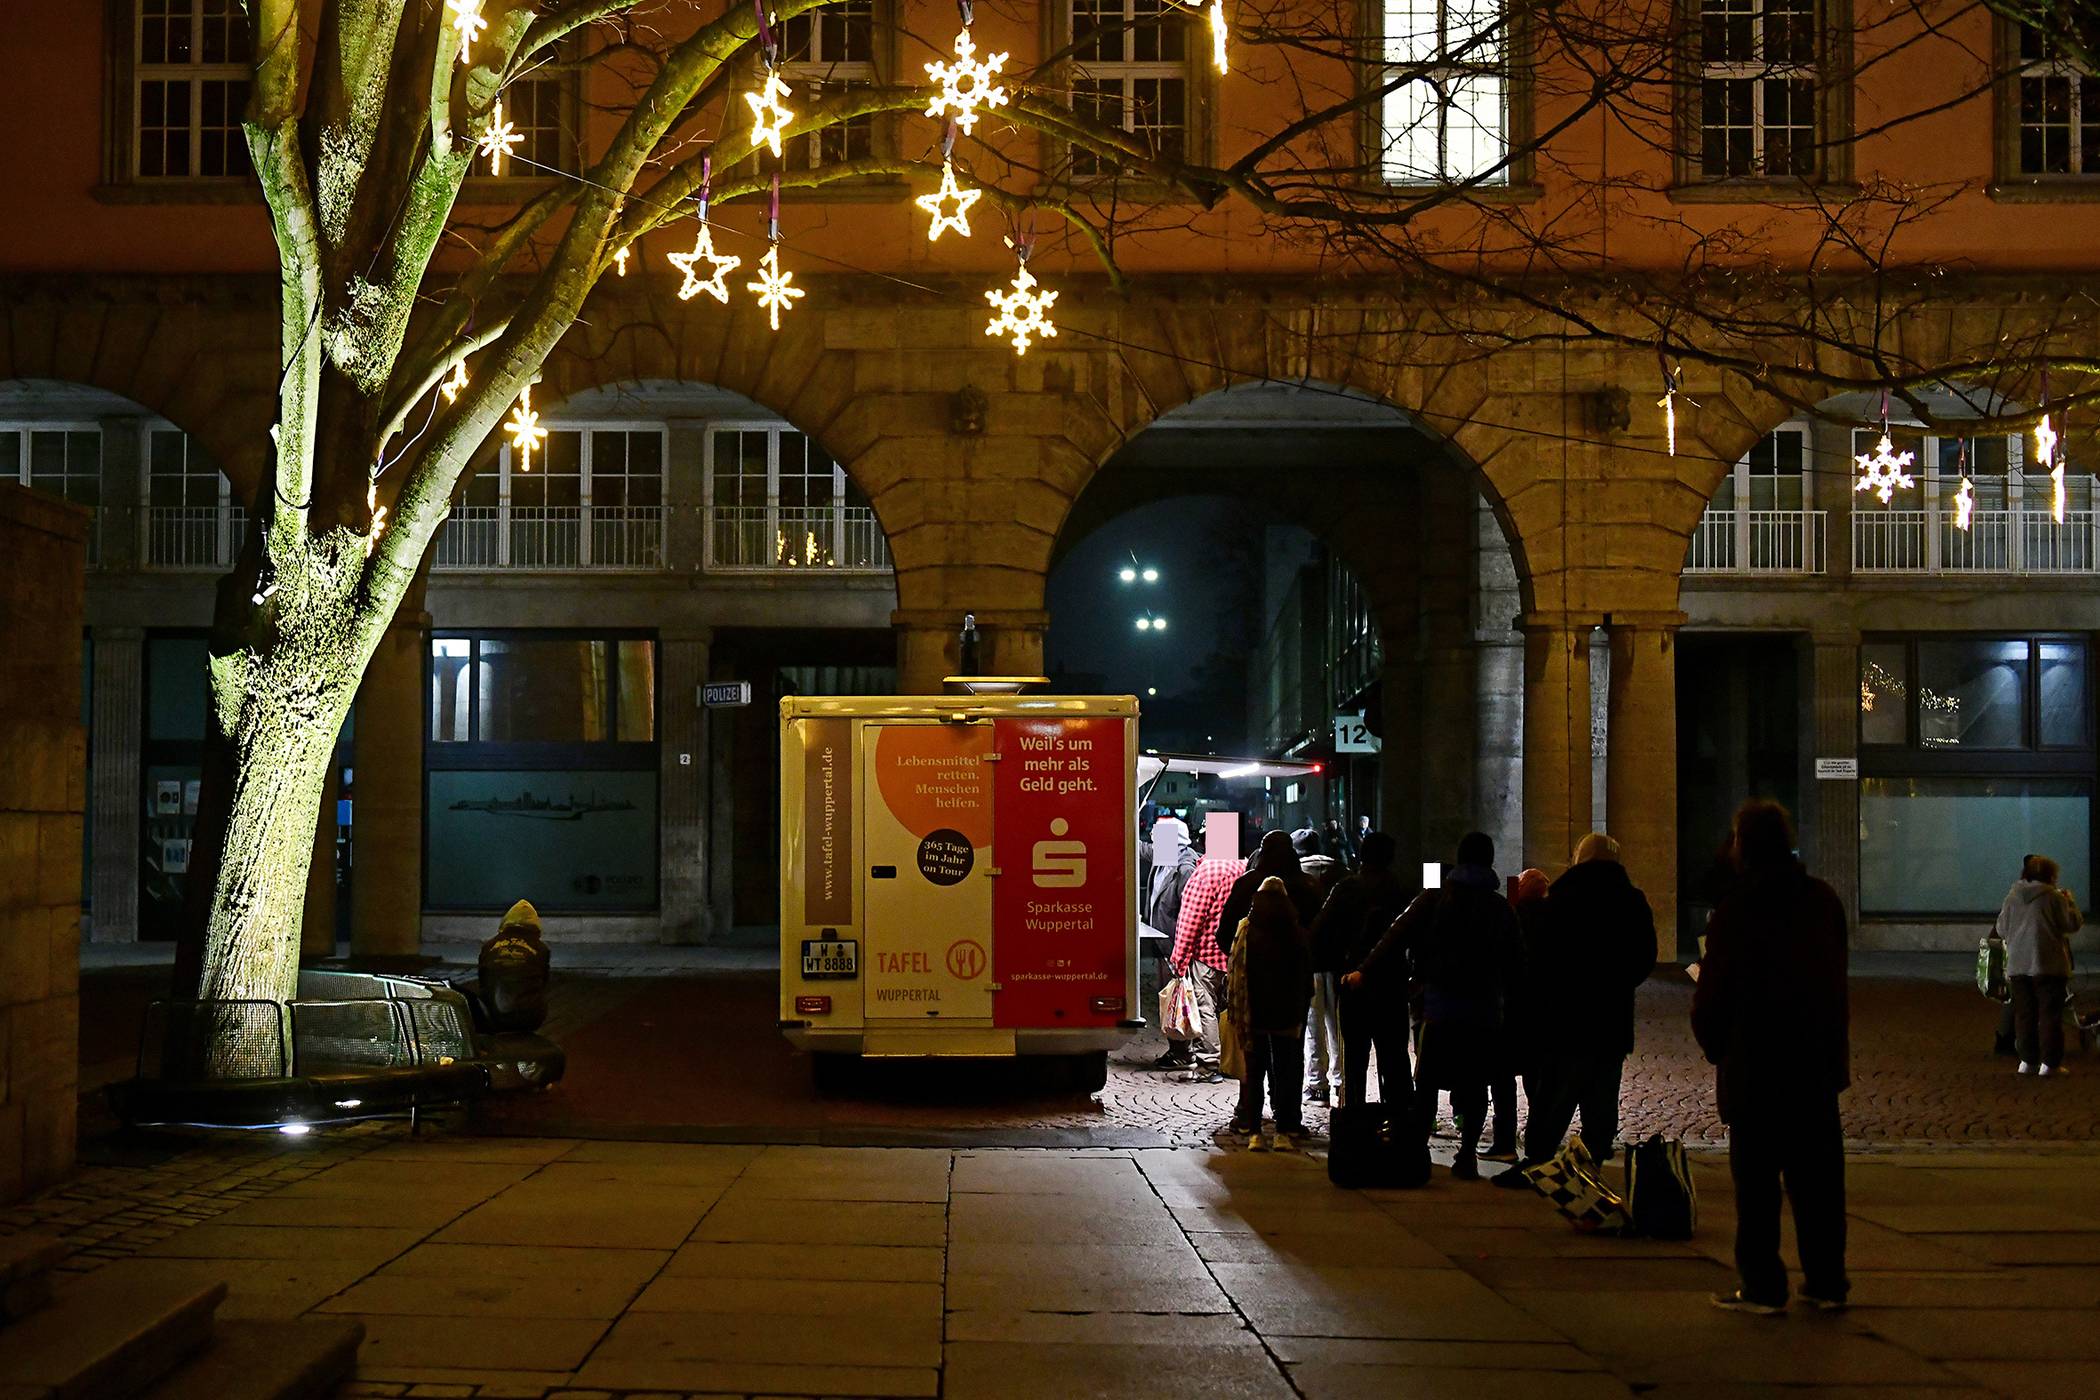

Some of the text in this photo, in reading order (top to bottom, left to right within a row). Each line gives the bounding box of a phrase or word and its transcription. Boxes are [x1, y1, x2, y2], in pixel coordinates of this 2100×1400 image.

[706, 687, 739, 702] POLIZEI
[1339, 724, 1367, 744] 12
[1019, 736, 1093, 751] Weil's um
[896, 755, 980, 767] Lebensmittel
[1024, 757, 1090, 771] mehr als
[937, 770, 980, 780] retten.
[915, 783, 980, 794] Menschen
[1020, 777, 1098, 794] Geld geht.
[936, 797, 980, 808] helfen.
[822, 746, 835, 901] www.tafel-wuppertal.de
[924, 841, 969, 854] 365 Tage
[925, 851, 966, 865] im Jahr
[939, 865, 964, 876] Tour
[1027, 901, 1093, 916] Sparkasse
[1025, 917, 1094, 932] Wuppertal
[820, 944, 828, 957] W
[806, 958, 853, 971] WT 8888
[878, 952, 932, 973] TAFEL
[1010, 972, 1108, 981] sparkasse-wuppertal.de
[877, 989, 941, 1001] WUPPERTAL
